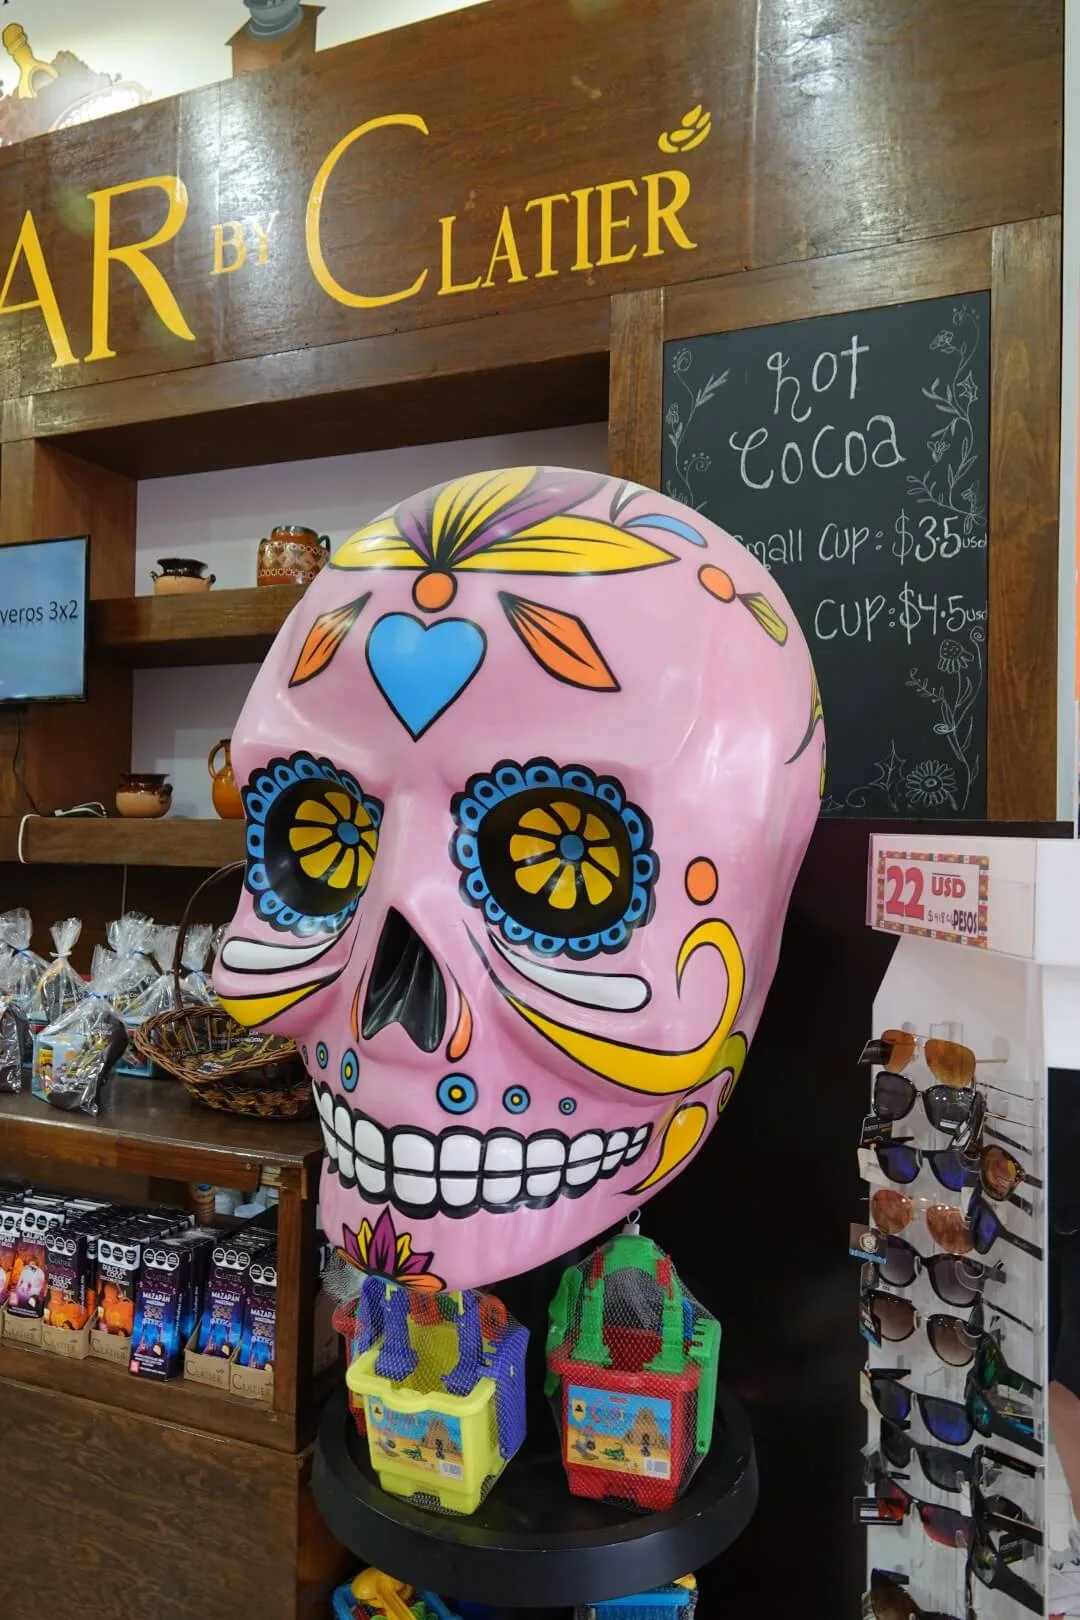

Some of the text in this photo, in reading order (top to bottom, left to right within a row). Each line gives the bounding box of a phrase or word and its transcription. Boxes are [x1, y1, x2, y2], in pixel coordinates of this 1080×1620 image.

[210, 211, 280, 276] BY
[49, 600, 79, 620] 3x2
[886, 864, 966, 921] 22 USD
[952, 909, 977, 934] PESOS
